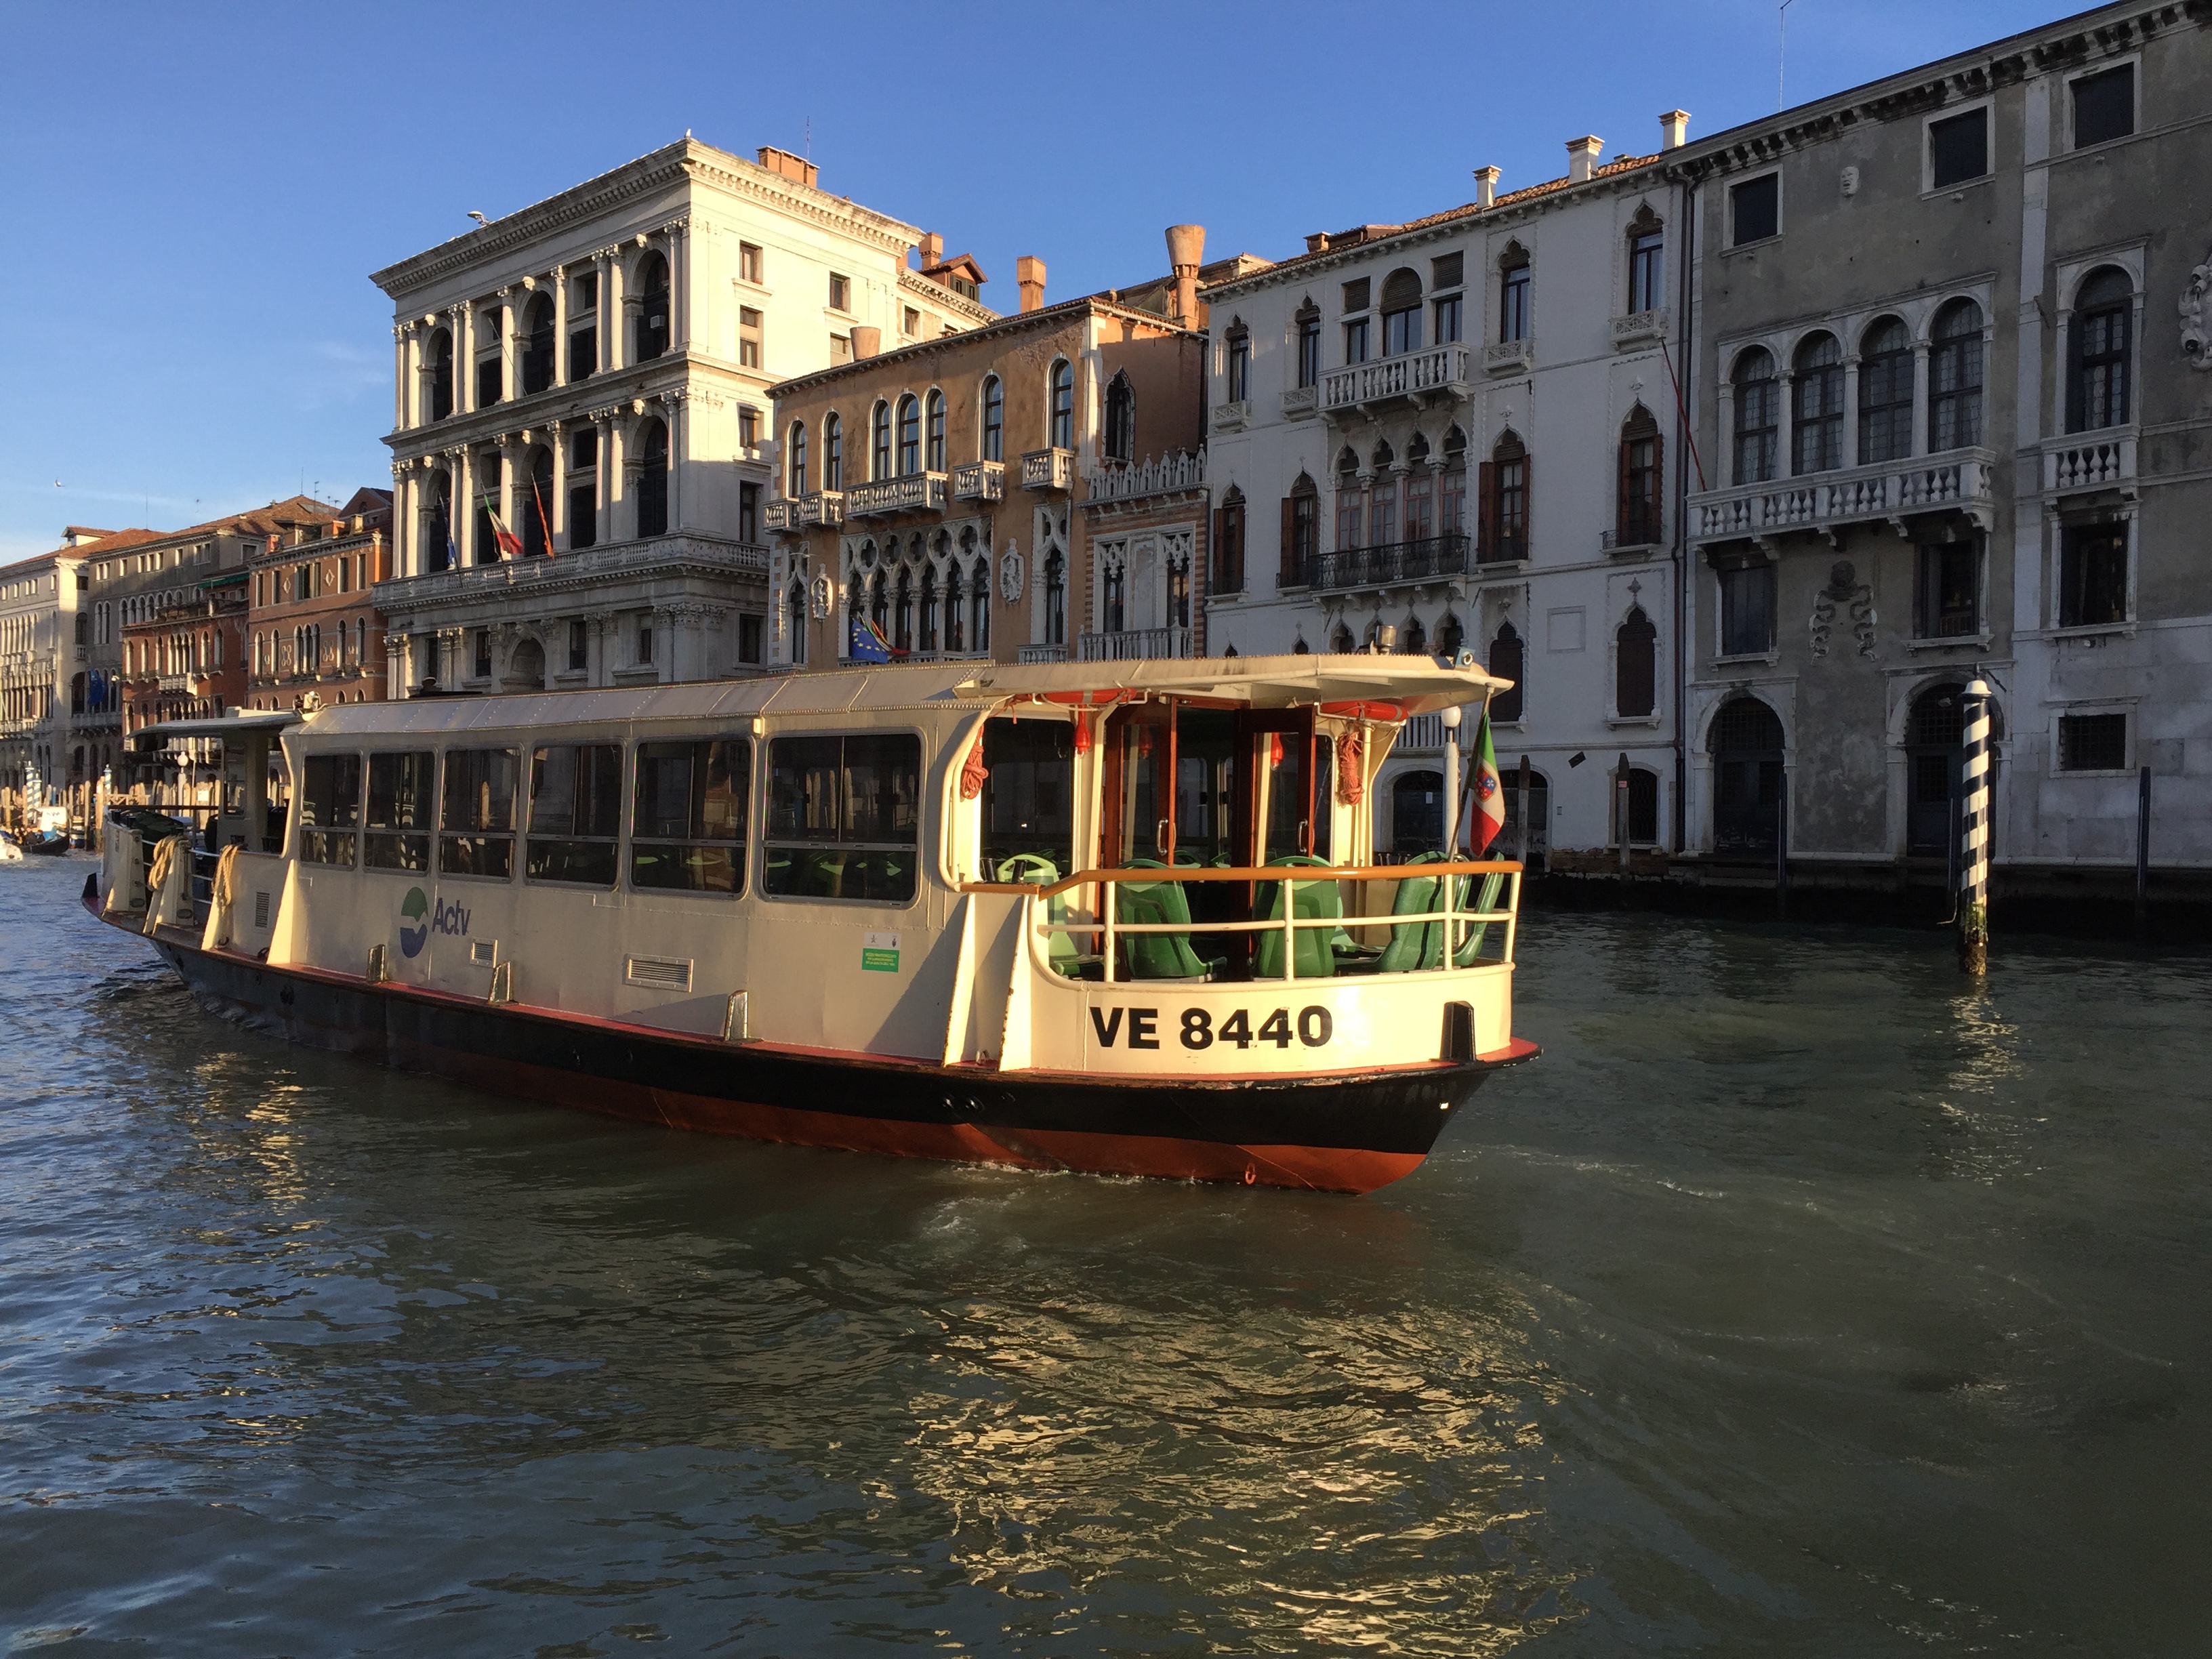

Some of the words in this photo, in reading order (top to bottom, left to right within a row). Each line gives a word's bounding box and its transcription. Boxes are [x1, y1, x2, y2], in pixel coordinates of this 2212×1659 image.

[432, 897, 471, 935] Actv
[1090, 1007, 1160, 1049] VE
[1179, 1006, 1333, 1050] 8440
